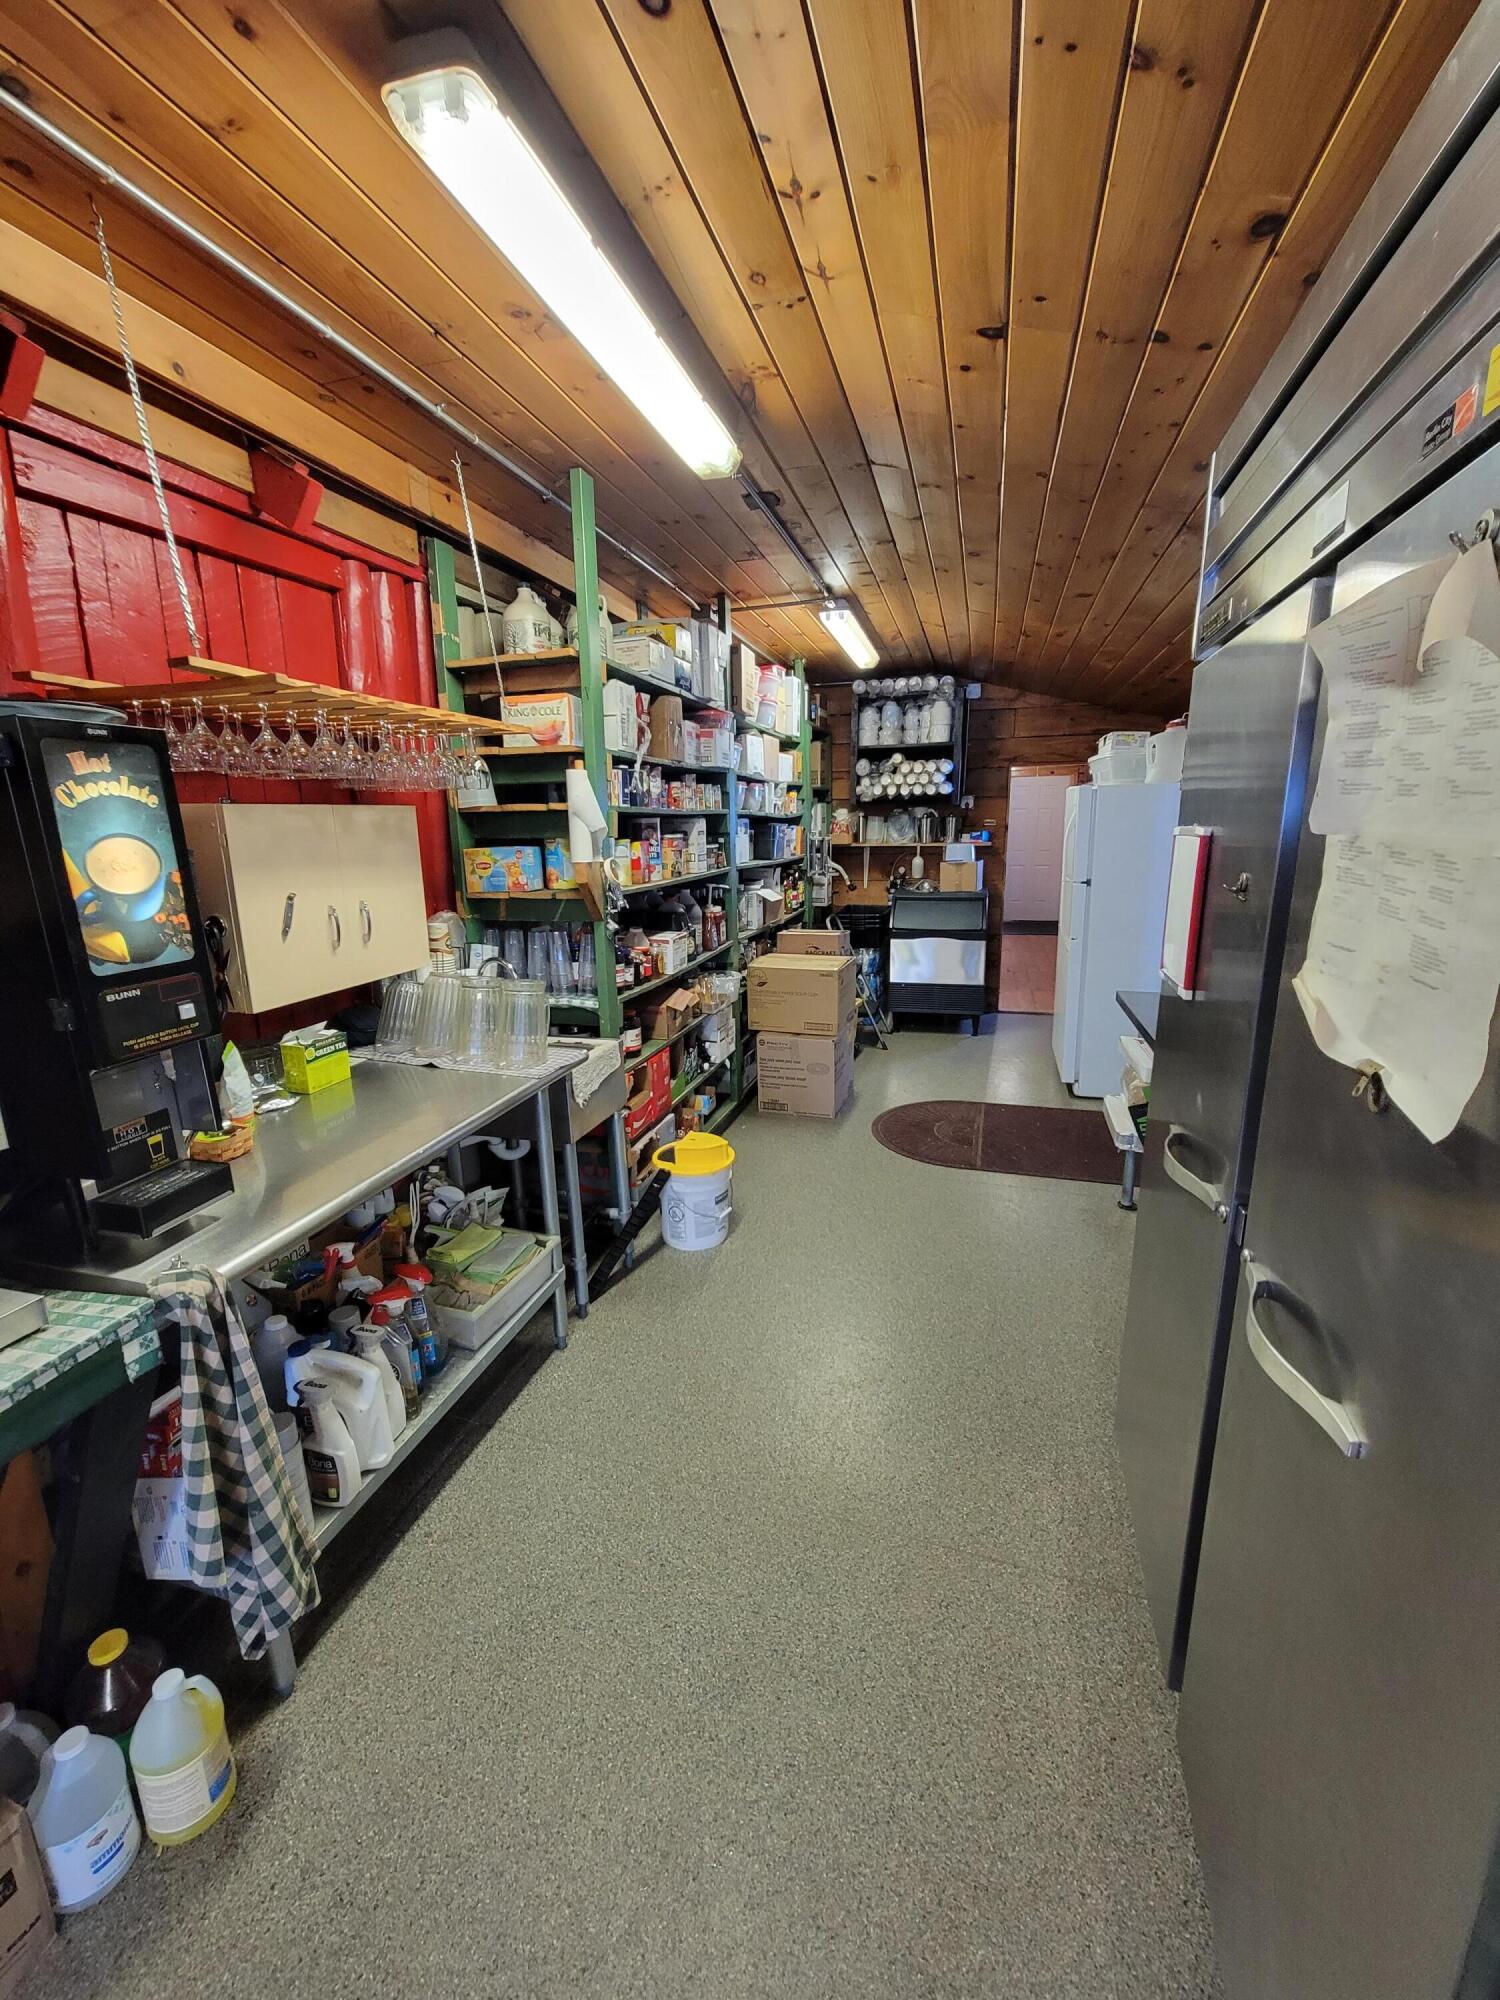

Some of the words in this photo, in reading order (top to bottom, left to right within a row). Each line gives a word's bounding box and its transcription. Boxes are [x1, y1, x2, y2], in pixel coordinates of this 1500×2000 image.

[507, 706, 530, 718] KING
[539, 705, 562, 716] COLE
[66, 750, 112, 776] Hot
[54, 775, 159, 809] Chocolate
[106, 988, 140, 1002] BUNN
[316, 1045, 335, 1056] GREEN
[335, 1042, 346, 1050] TEA
[355, 1326, 378, 1334] Bona
[303, 1380, 328, 1389] Bona
[310, 1457, 333, 1468] Bona
